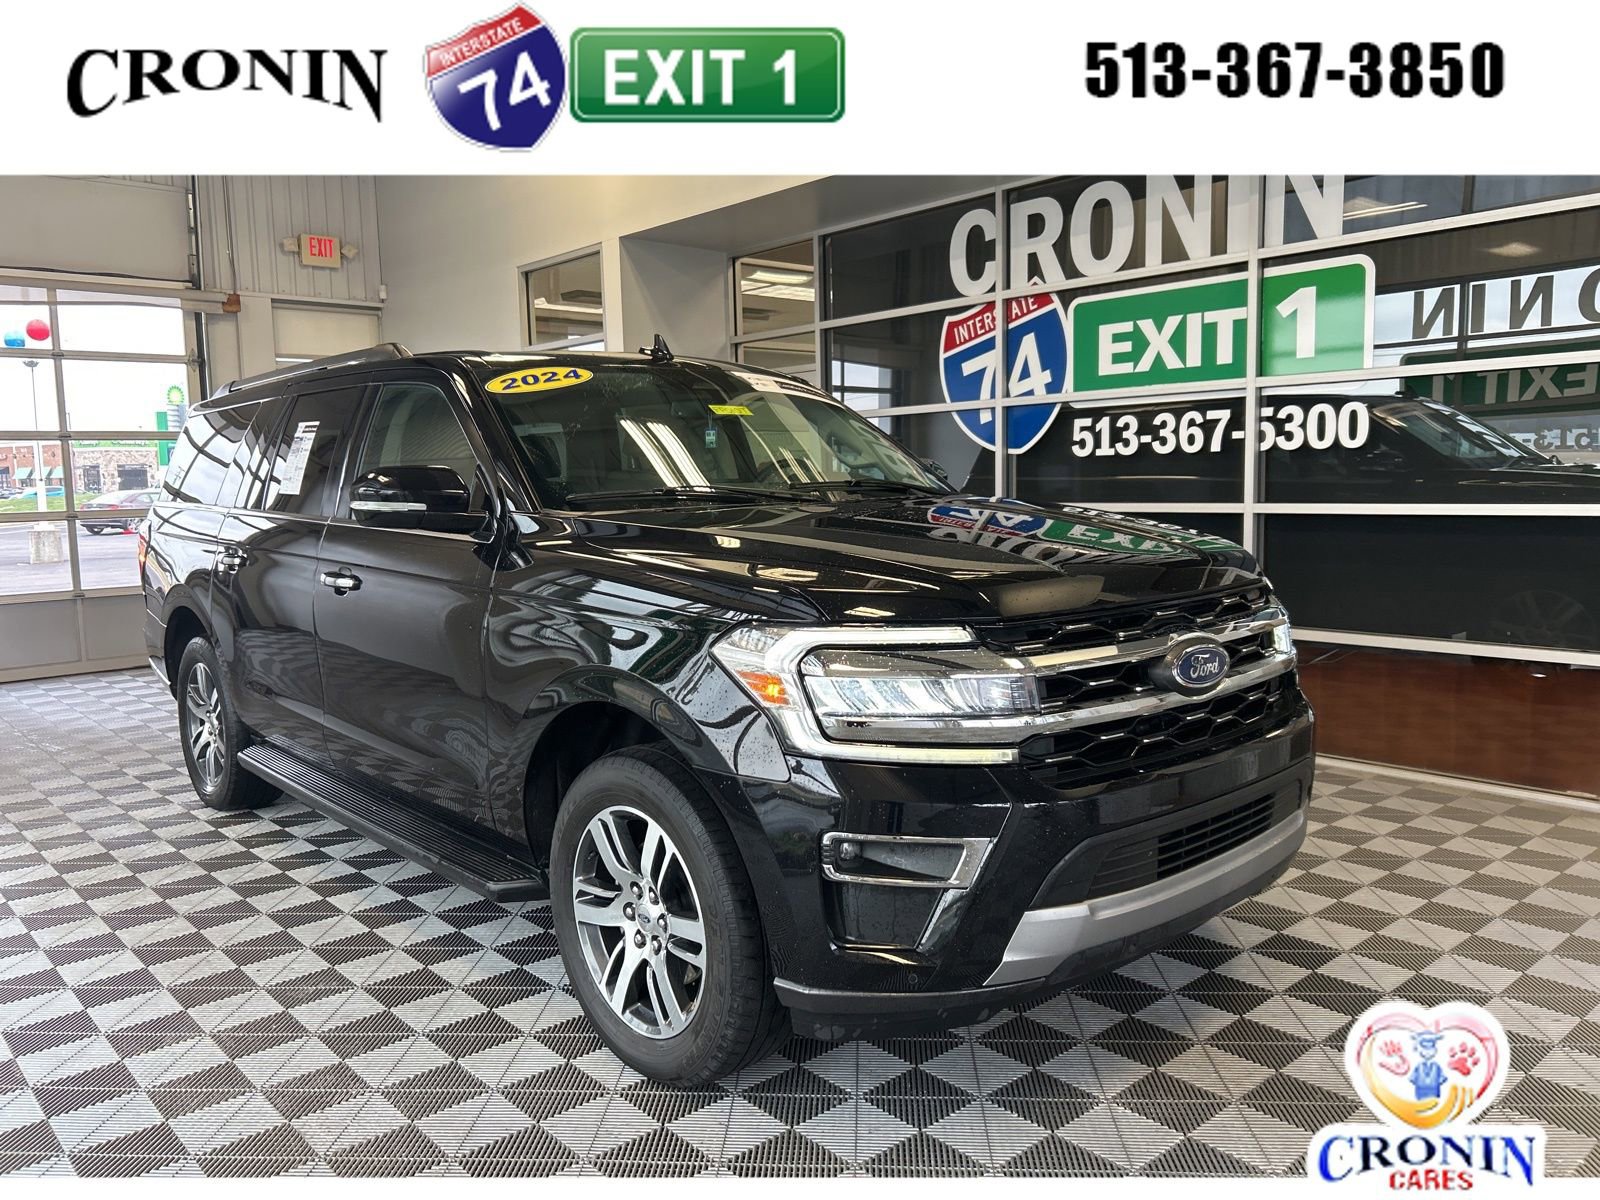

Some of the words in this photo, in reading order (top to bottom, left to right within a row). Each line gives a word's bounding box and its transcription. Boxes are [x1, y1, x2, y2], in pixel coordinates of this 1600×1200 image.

[309, 237, 333, 258] EXIT
[954, 296, 1038, 345] INTERATE
[1098, 307, 1248, 377] EXIT
[1275, 286, 1317, 359] 1
[500, 369, 583, 391] 2024
[961, 332, 1052, 425] 74
[1071, 401, 1369, 457] 513-367-5300
[1190, 653, 1220, 678] Ford
